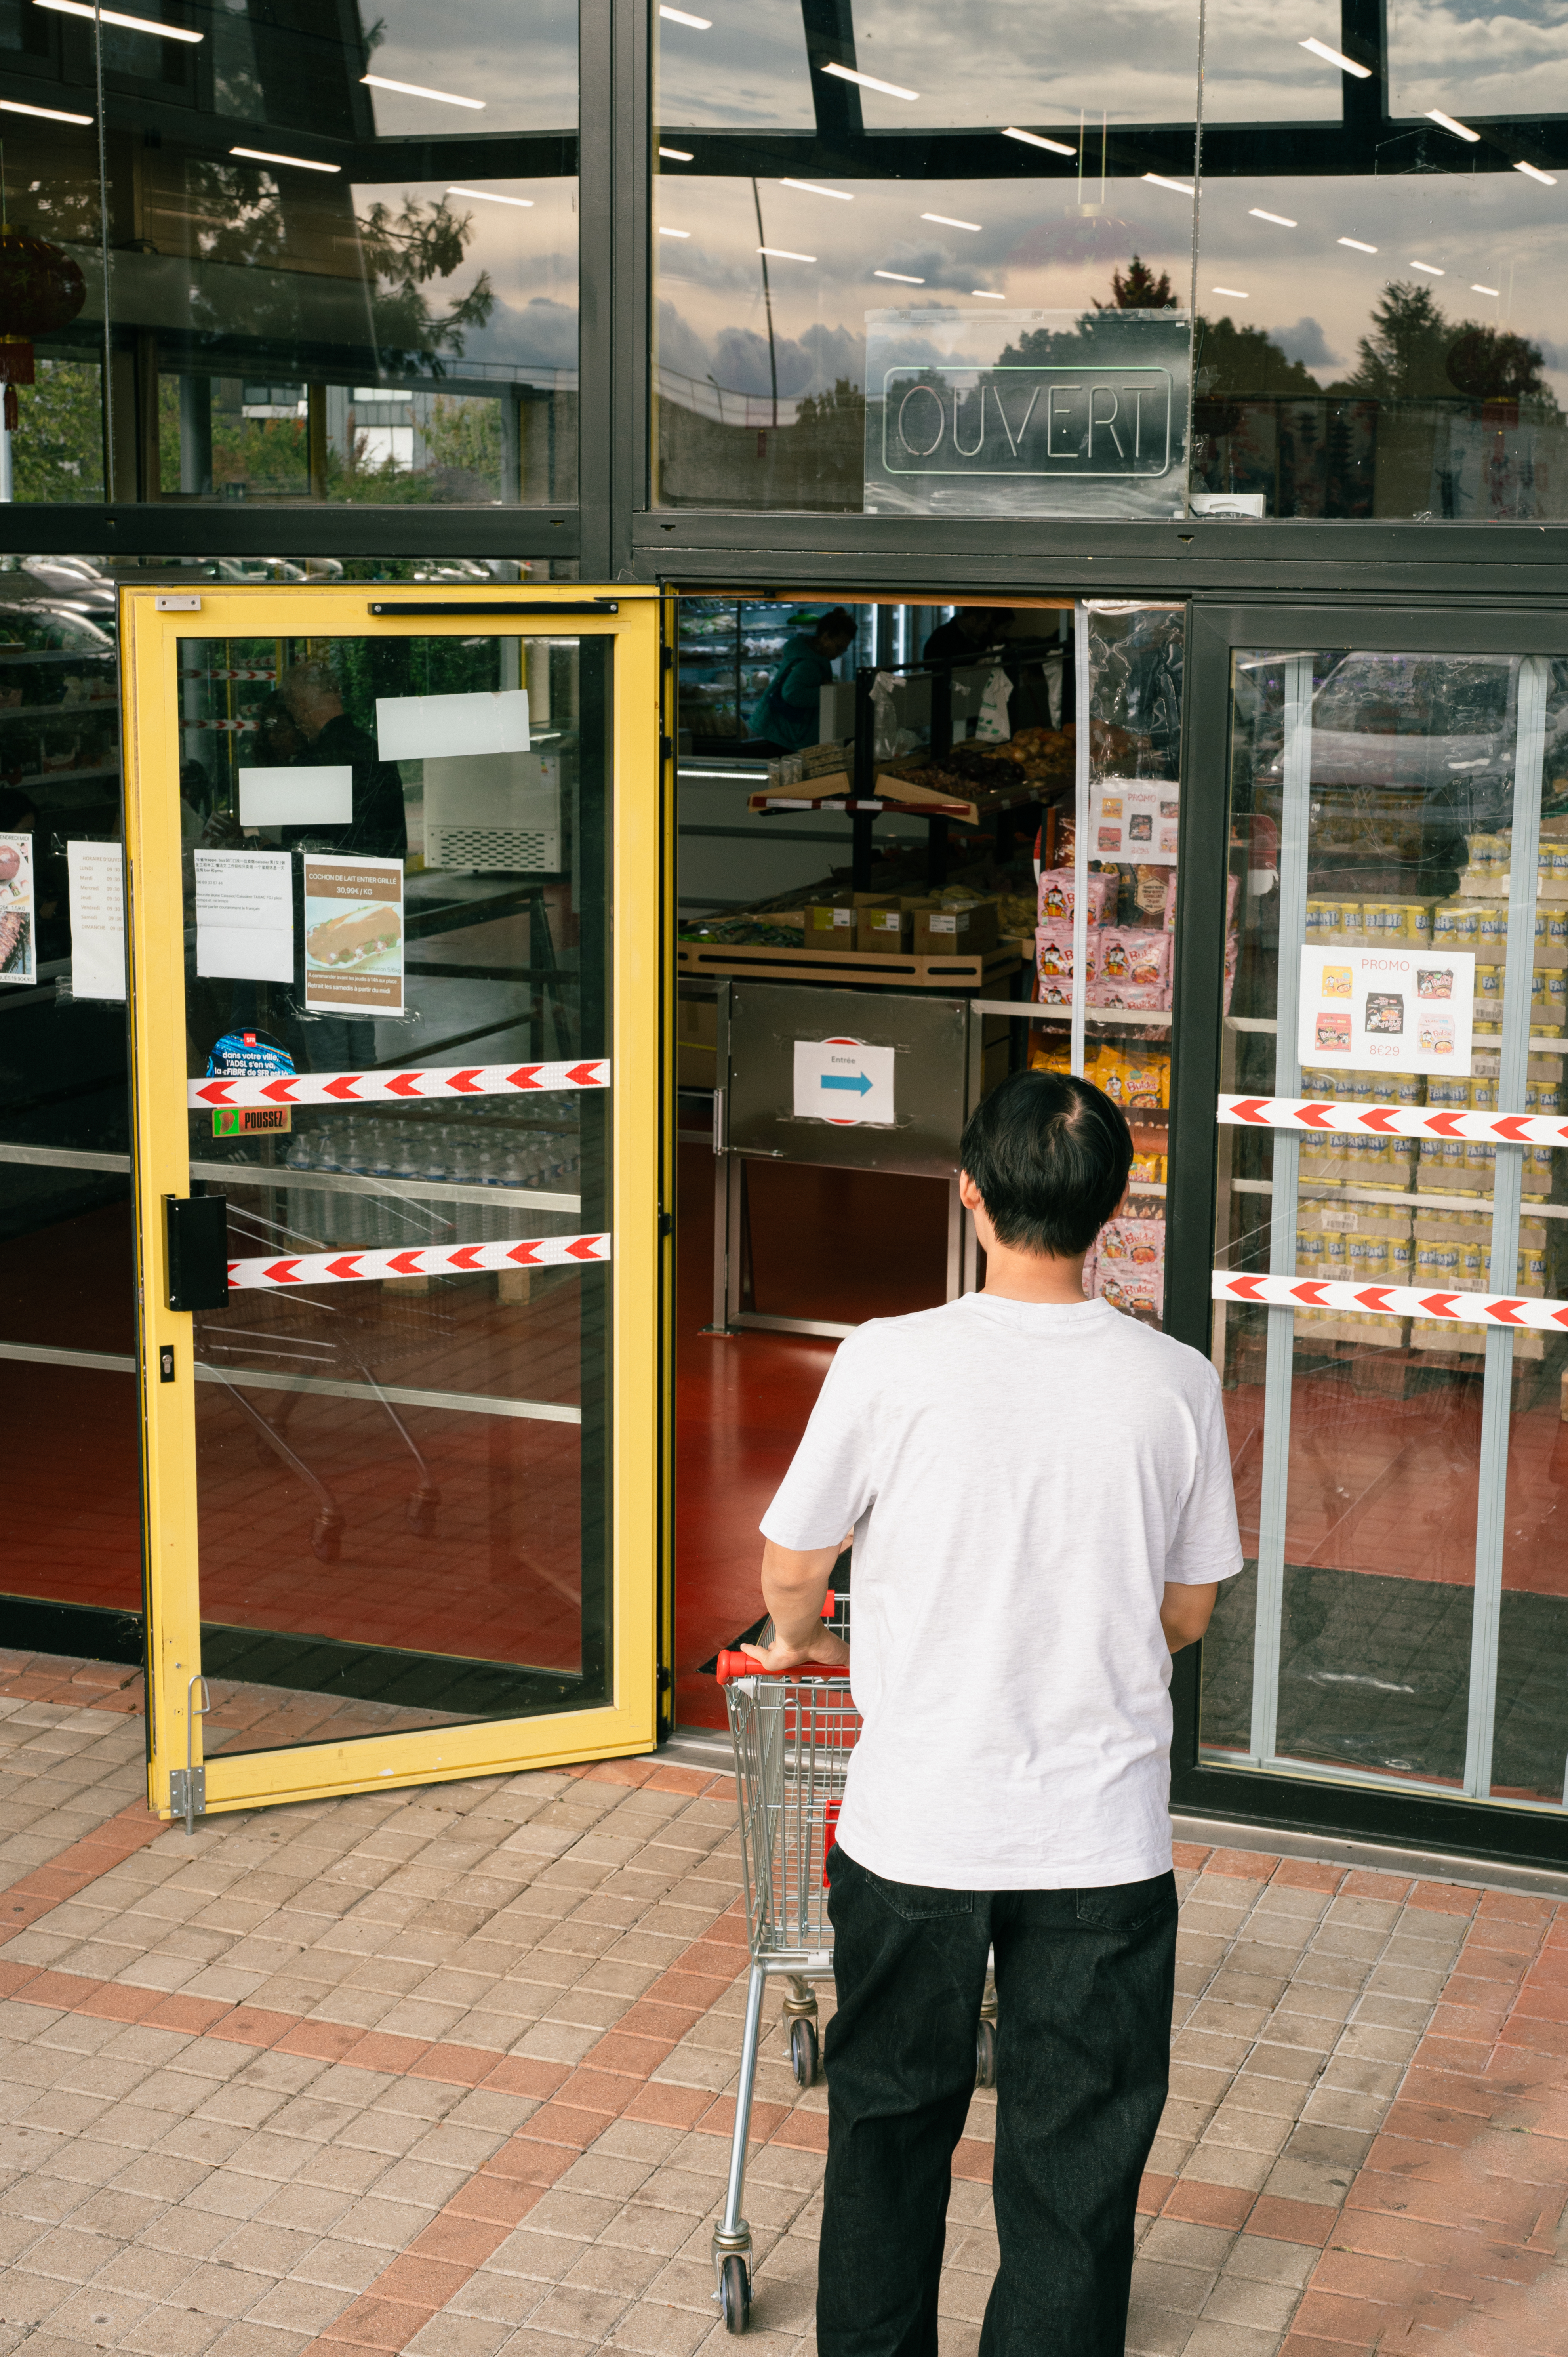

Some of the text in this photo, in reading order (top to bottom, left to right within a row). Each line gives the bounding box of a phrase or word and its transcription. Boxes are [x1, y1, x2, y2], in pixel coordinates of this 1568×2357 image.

[899, 385, 1157, 458] OUVERT
[1362, 959, 1410, 971] PROMO
[1370, 1045, 1399, 1056] 8€29
[263, 1053, 279, 1062] ville,
[831, 1056, 855, 1064] Entrée
[245, 1111, 283, 1129] POUSSEZ
